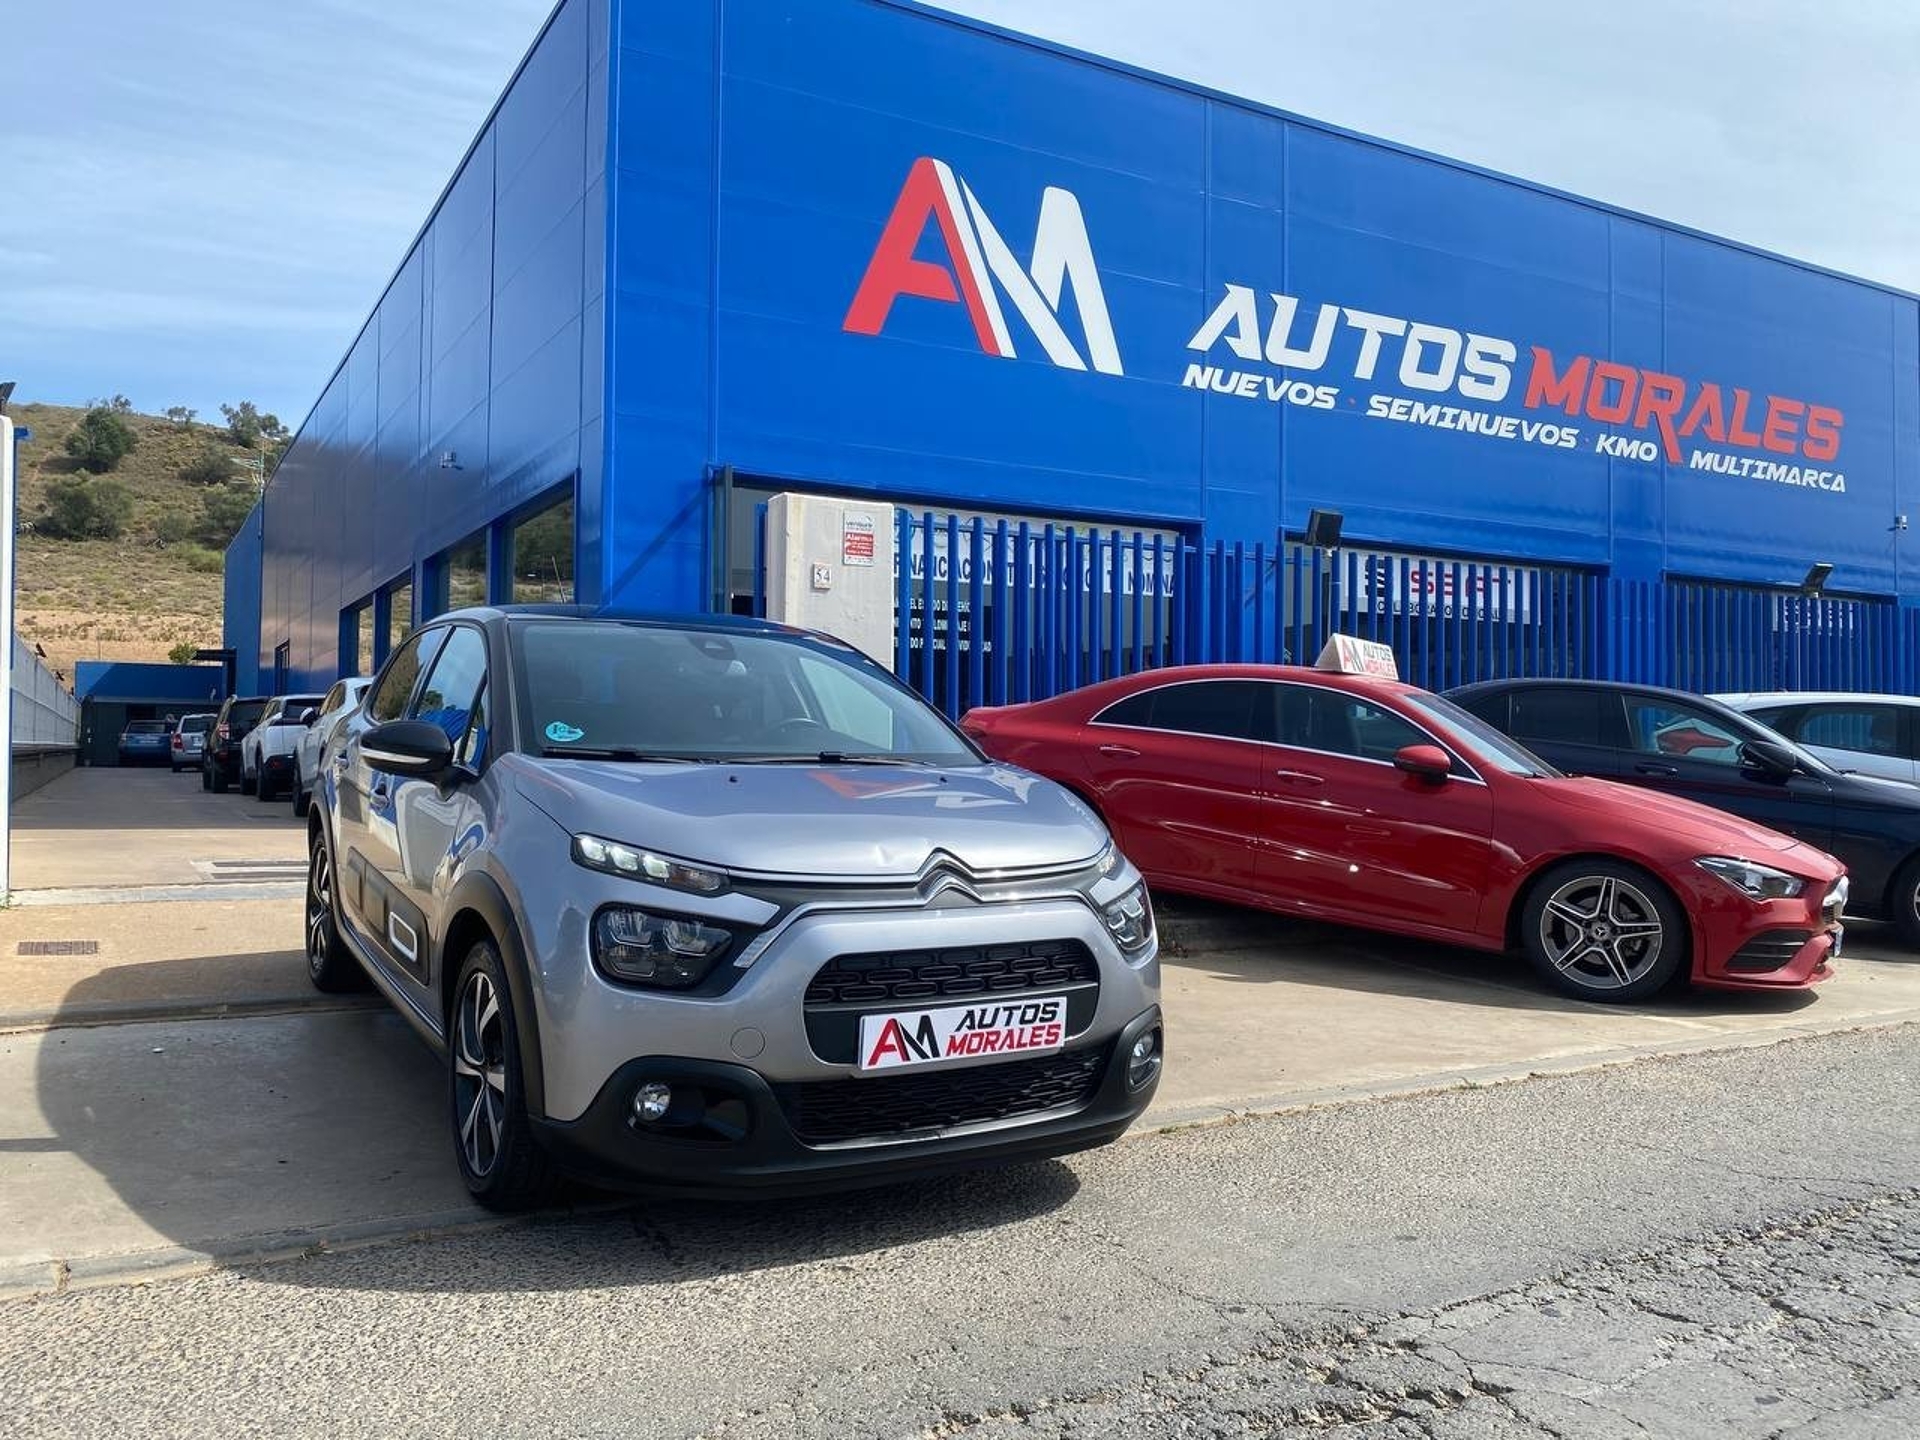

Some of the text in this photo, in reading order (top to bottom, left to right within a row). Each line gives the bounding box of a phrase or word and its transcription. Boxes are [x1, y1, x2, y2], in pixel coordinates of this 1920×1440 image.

[842, 156, 1124, 376] AM
[1187, 283, 1844, 464] AUTOS MORALES
[1182, 364, 1339, 410] NUEVOS
[1366, 394, 1580, 449] SEMINUEVOS
[1690, 450, 1846, 493] MULTIMARCA
[816, 567, 830, 582] 54
[868, 1014, 941, 1067] AM
[946, 1024, 1062, 1057] MORALES
[955, 1001, 1060, 1033] AUTOS
